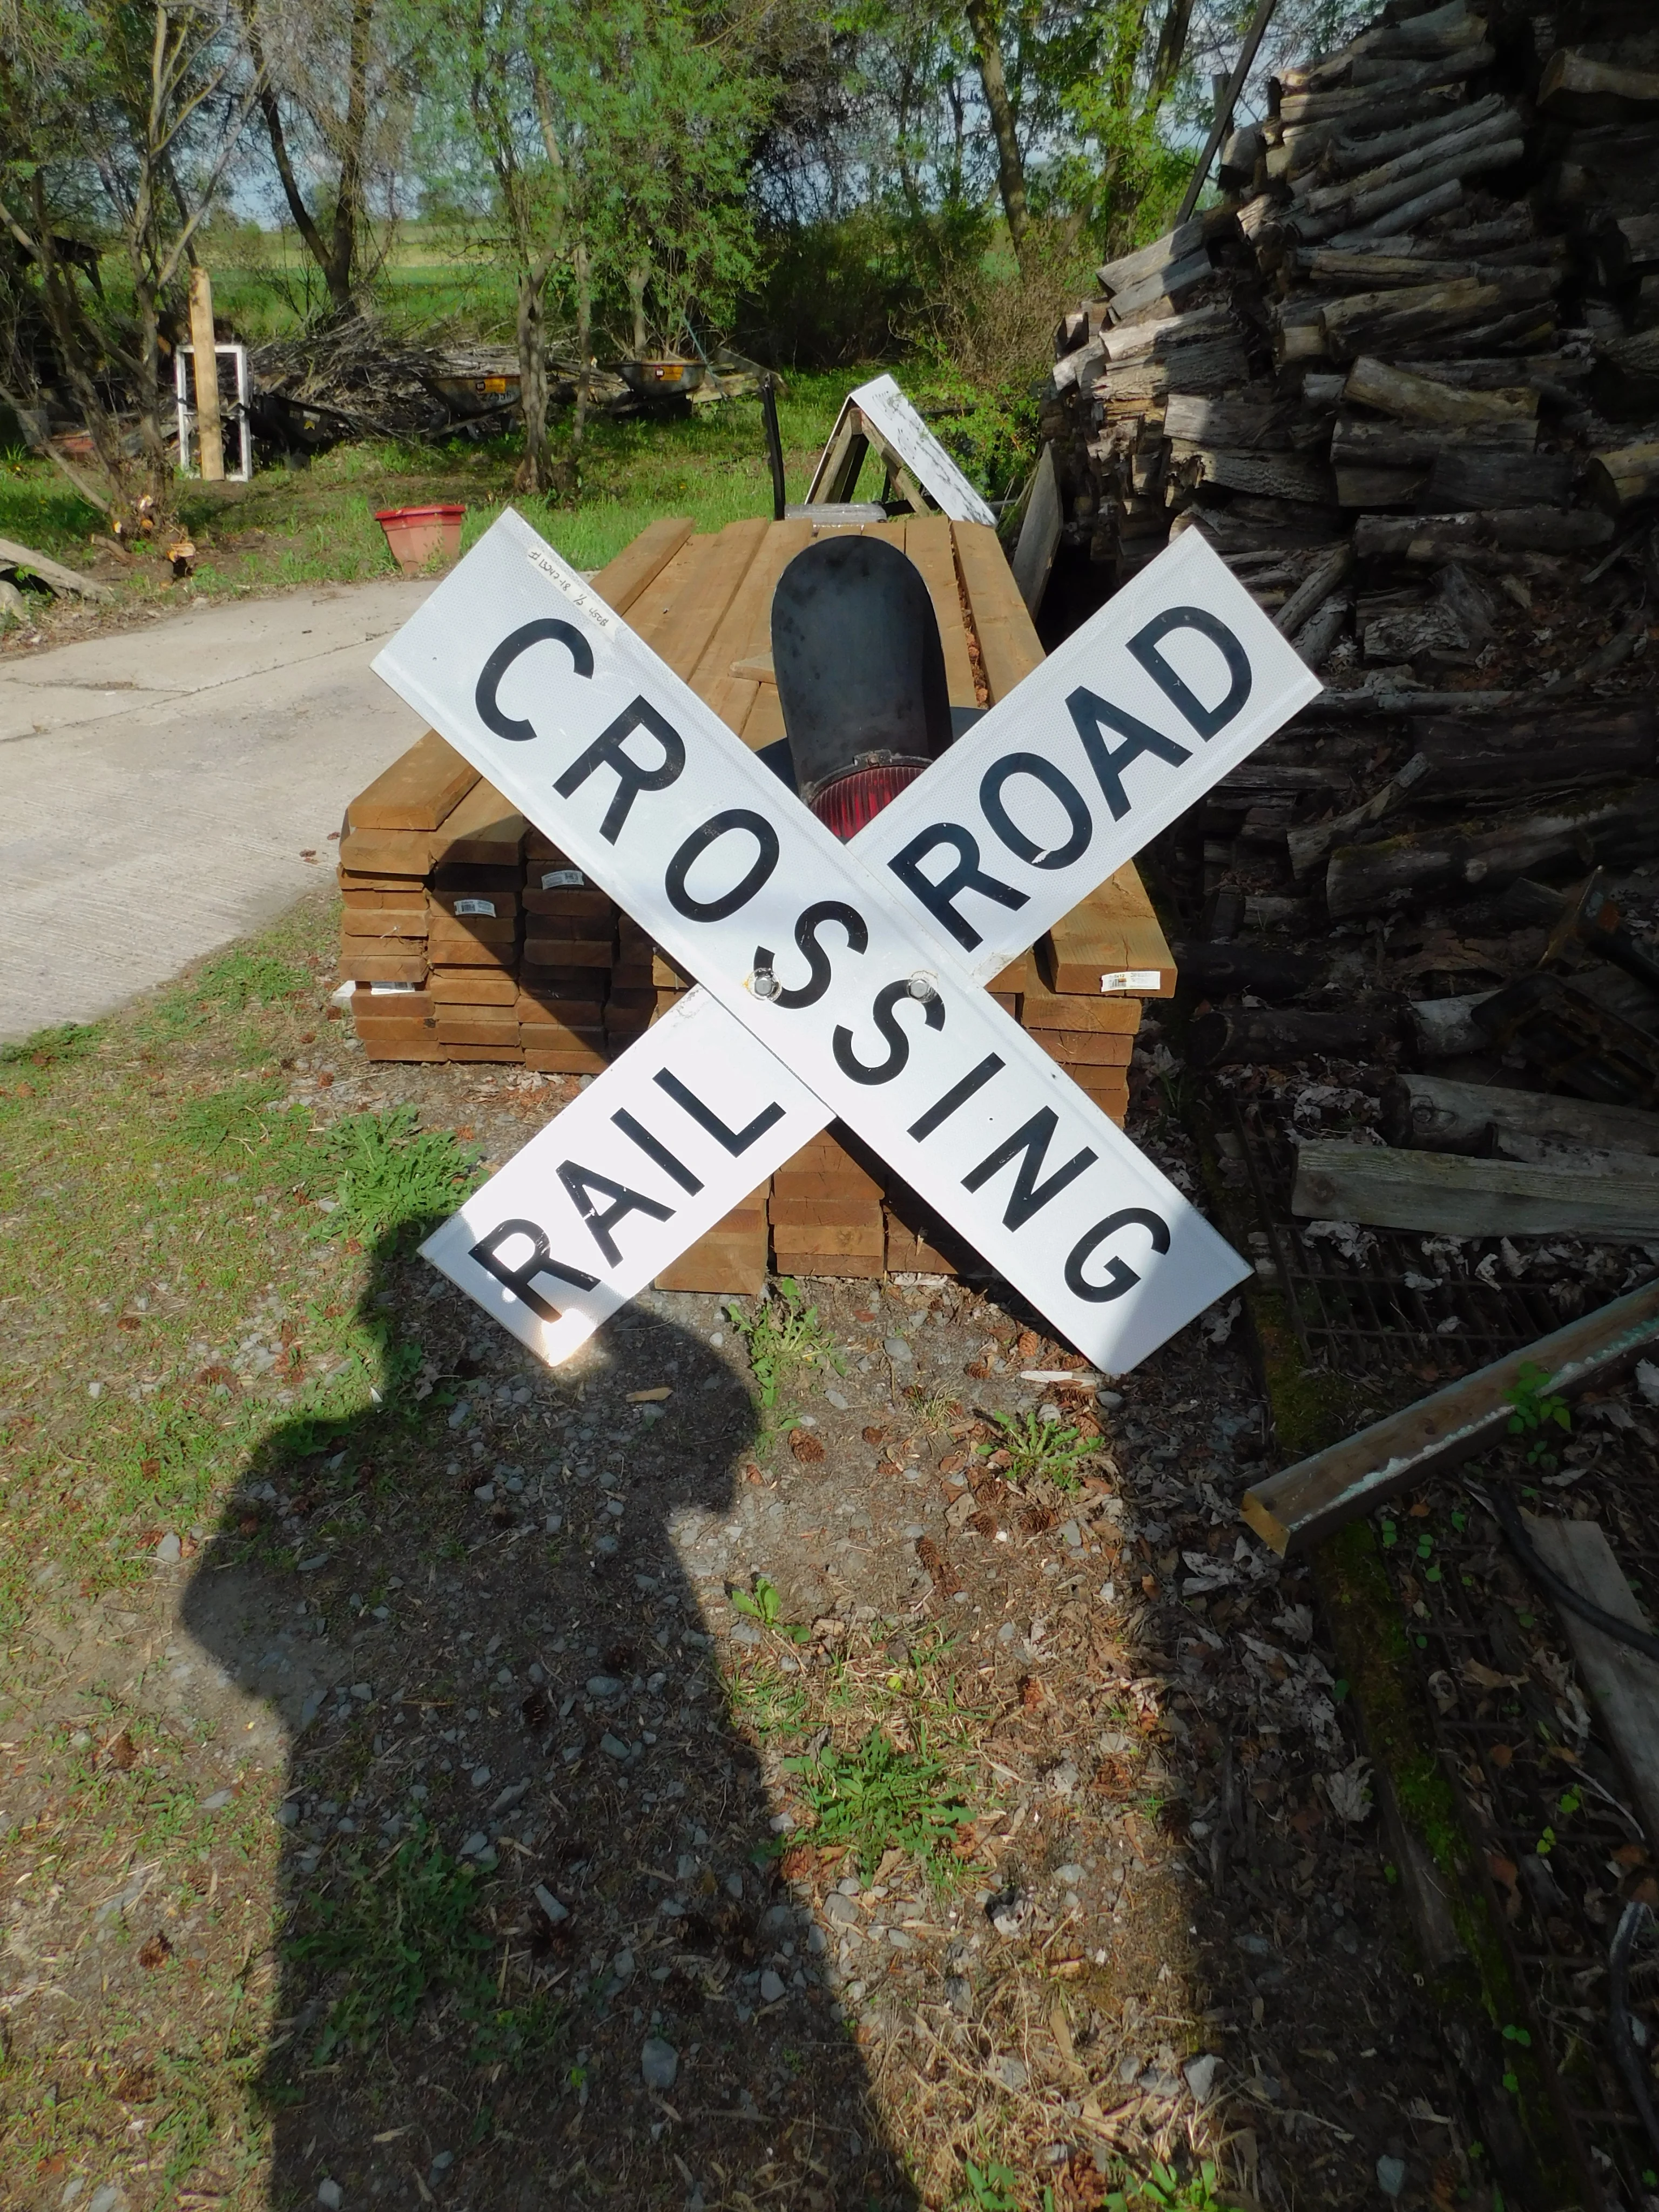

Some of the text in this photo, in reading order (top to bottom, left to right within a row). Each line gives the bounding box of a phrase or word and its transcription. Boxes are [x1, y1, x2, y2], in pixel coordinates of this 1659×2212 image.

[888, 606, 1252, 952] ROAD
[475, 618, 1170, 1303] CROSSING
[468, 1067, 786, 1323] RAIL
